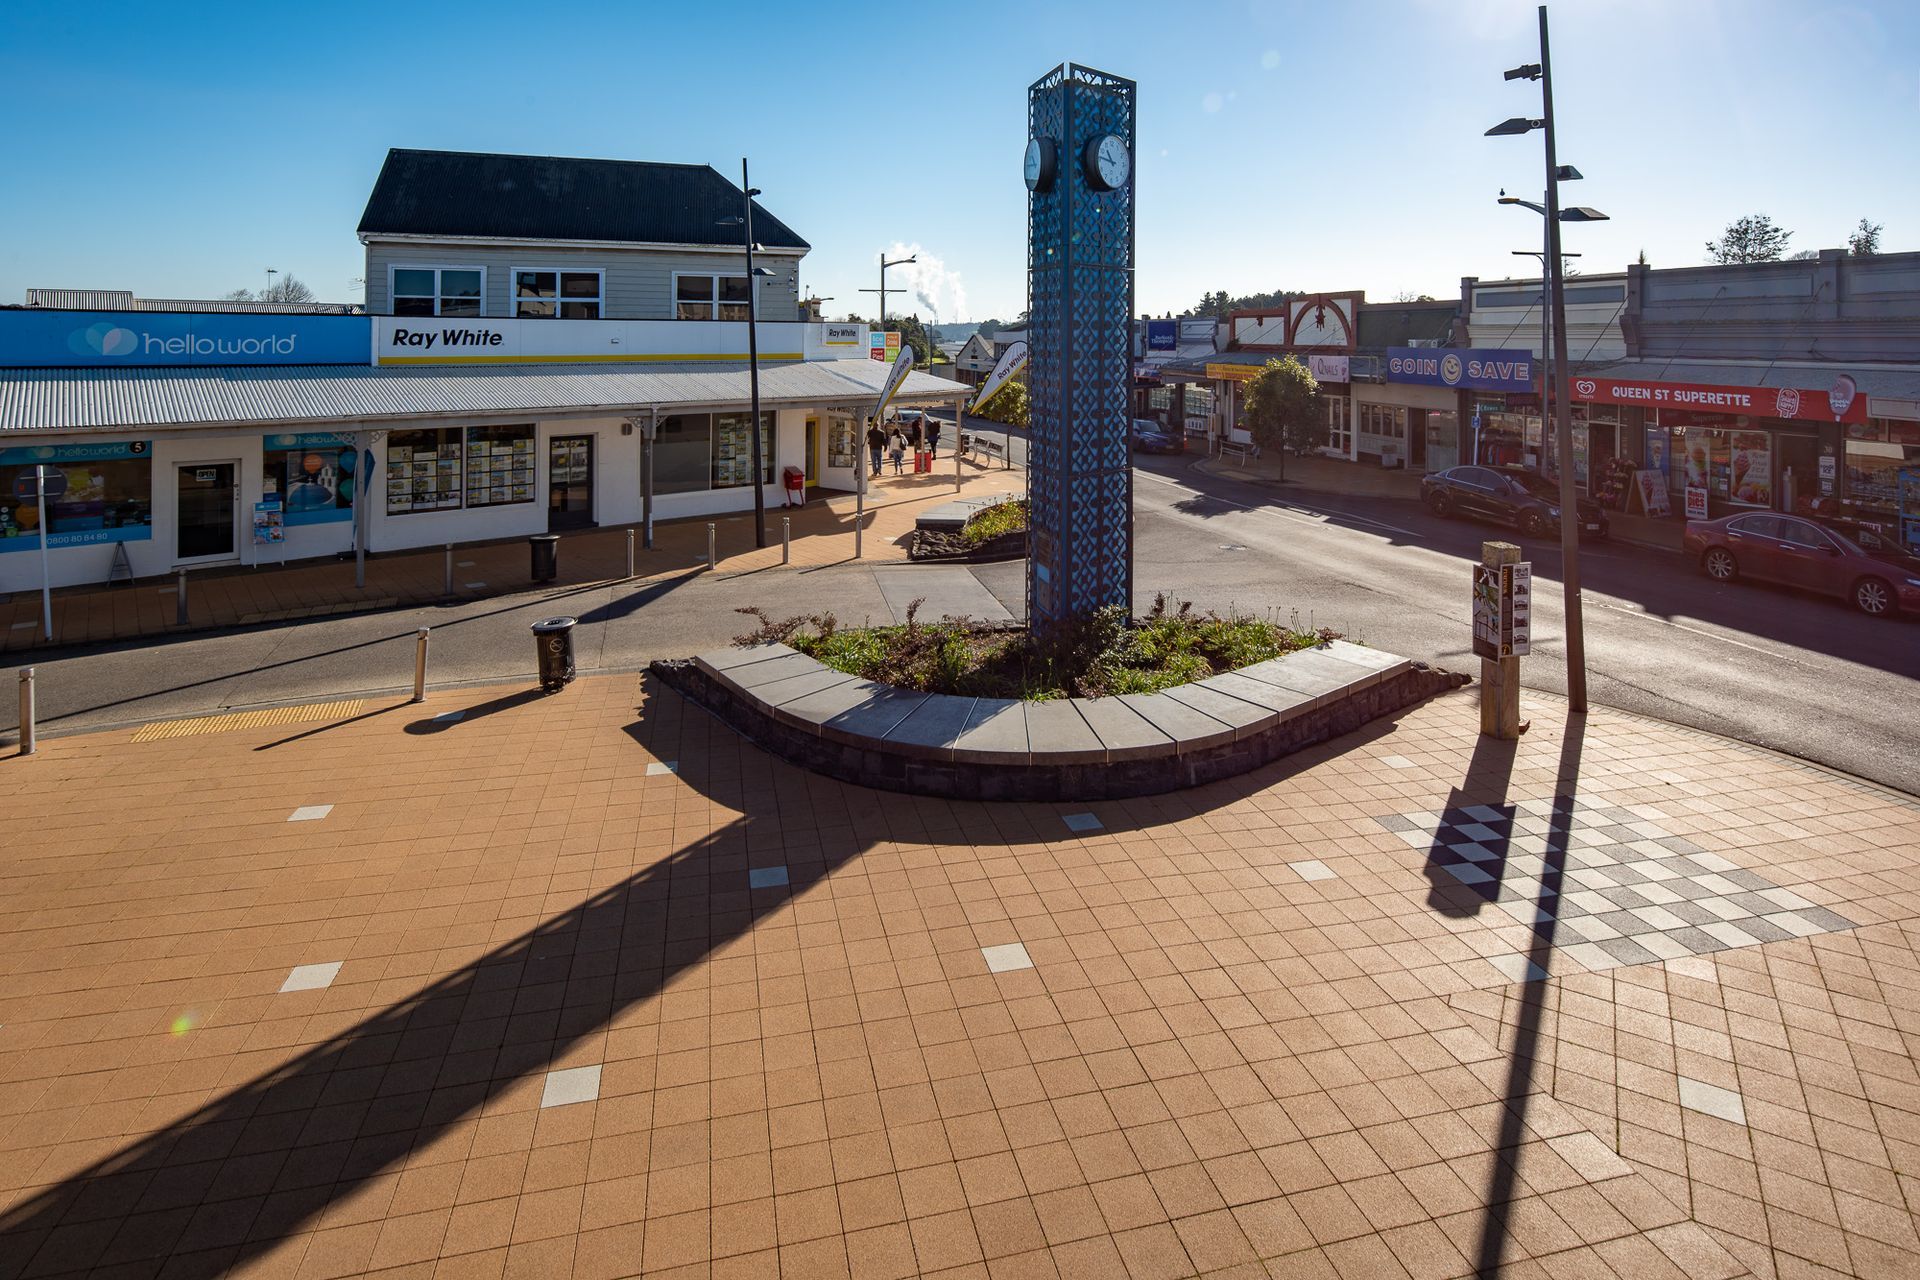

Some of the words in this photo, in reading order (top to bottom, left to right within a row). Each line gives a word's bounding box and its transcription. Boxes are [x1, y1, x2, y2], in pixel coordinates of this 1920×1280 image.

[392, 328, 438, 350] Ray
[442, 329, 502, 346] White
[829, 328, 841, 338] Ray
[841, 329, 856, 337] White
[997, 366, 1011, 380] Ray
[1008, 351, 1027, 368] White
[1390, 357, 1437, 376] COIN
[1468, 360, 1530, 381] SAVE
[1612, 386, 1651, 400] QUEEN
[1655, 389, 1670, 401] ST
[1674, 390, 1751, 407] SUPERETTE
[134, 443, 142, 452] 5
[47, 536, 69, 545] 0800
